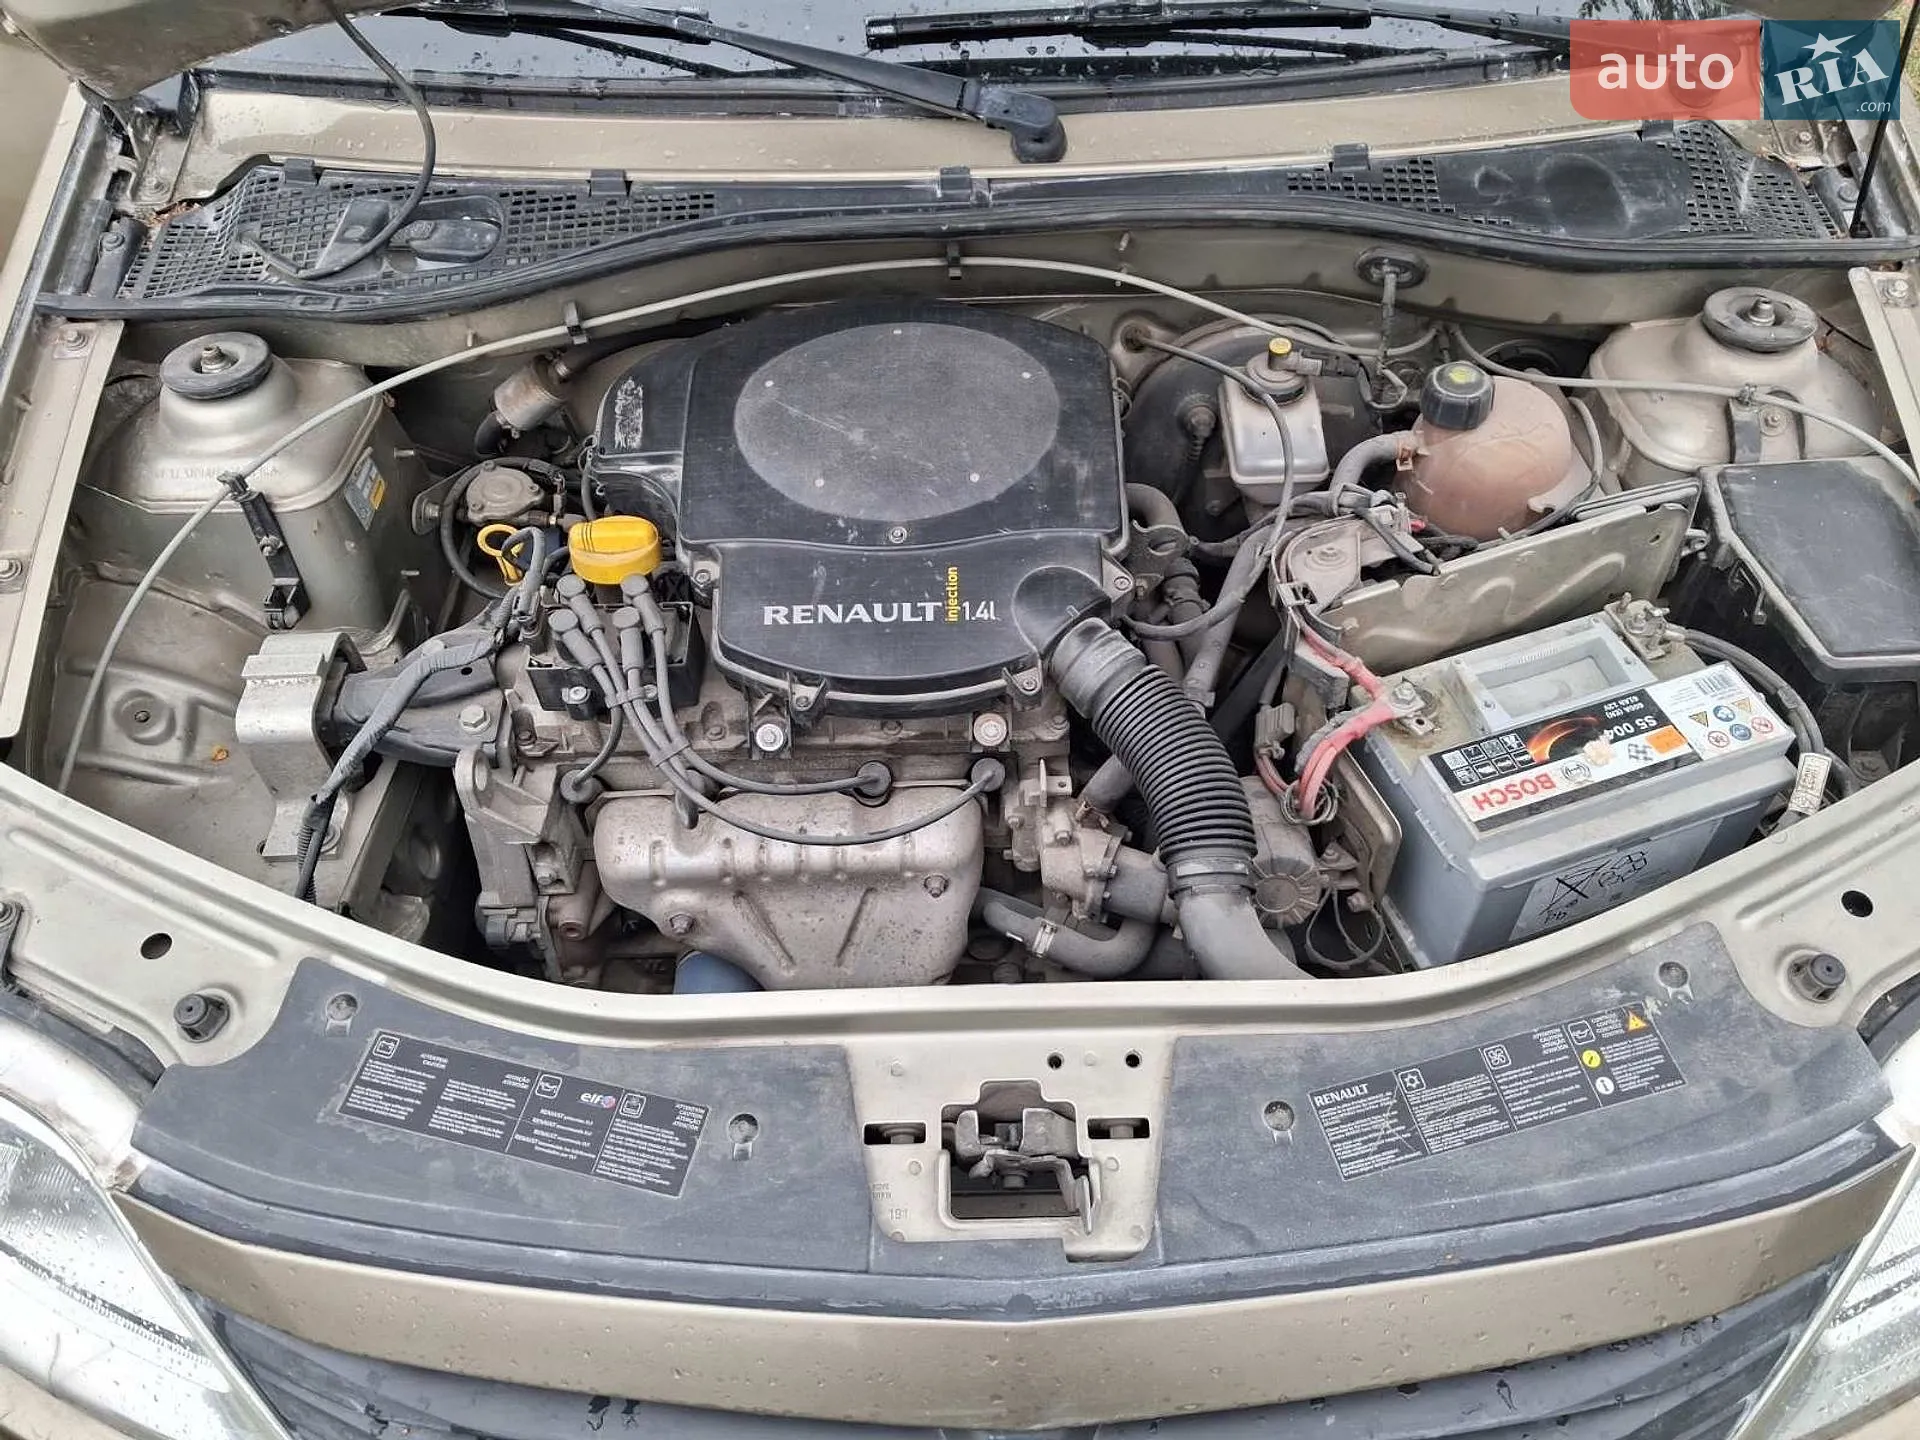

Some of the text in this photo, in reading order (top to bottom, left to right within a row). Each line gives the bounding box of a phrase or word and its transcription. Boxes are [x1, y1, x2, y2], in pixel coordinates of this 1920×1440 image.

[945, 566, 961, 622] injection
[763, 602, 942, 625] RENAULT
[1635, 715, 1658, 730] S5
[1472, 772, 1556, 811] BOSCH
[580, 1092, 603, 1104] elf
[1313, 1083, 1368, 1107] RENAULT
